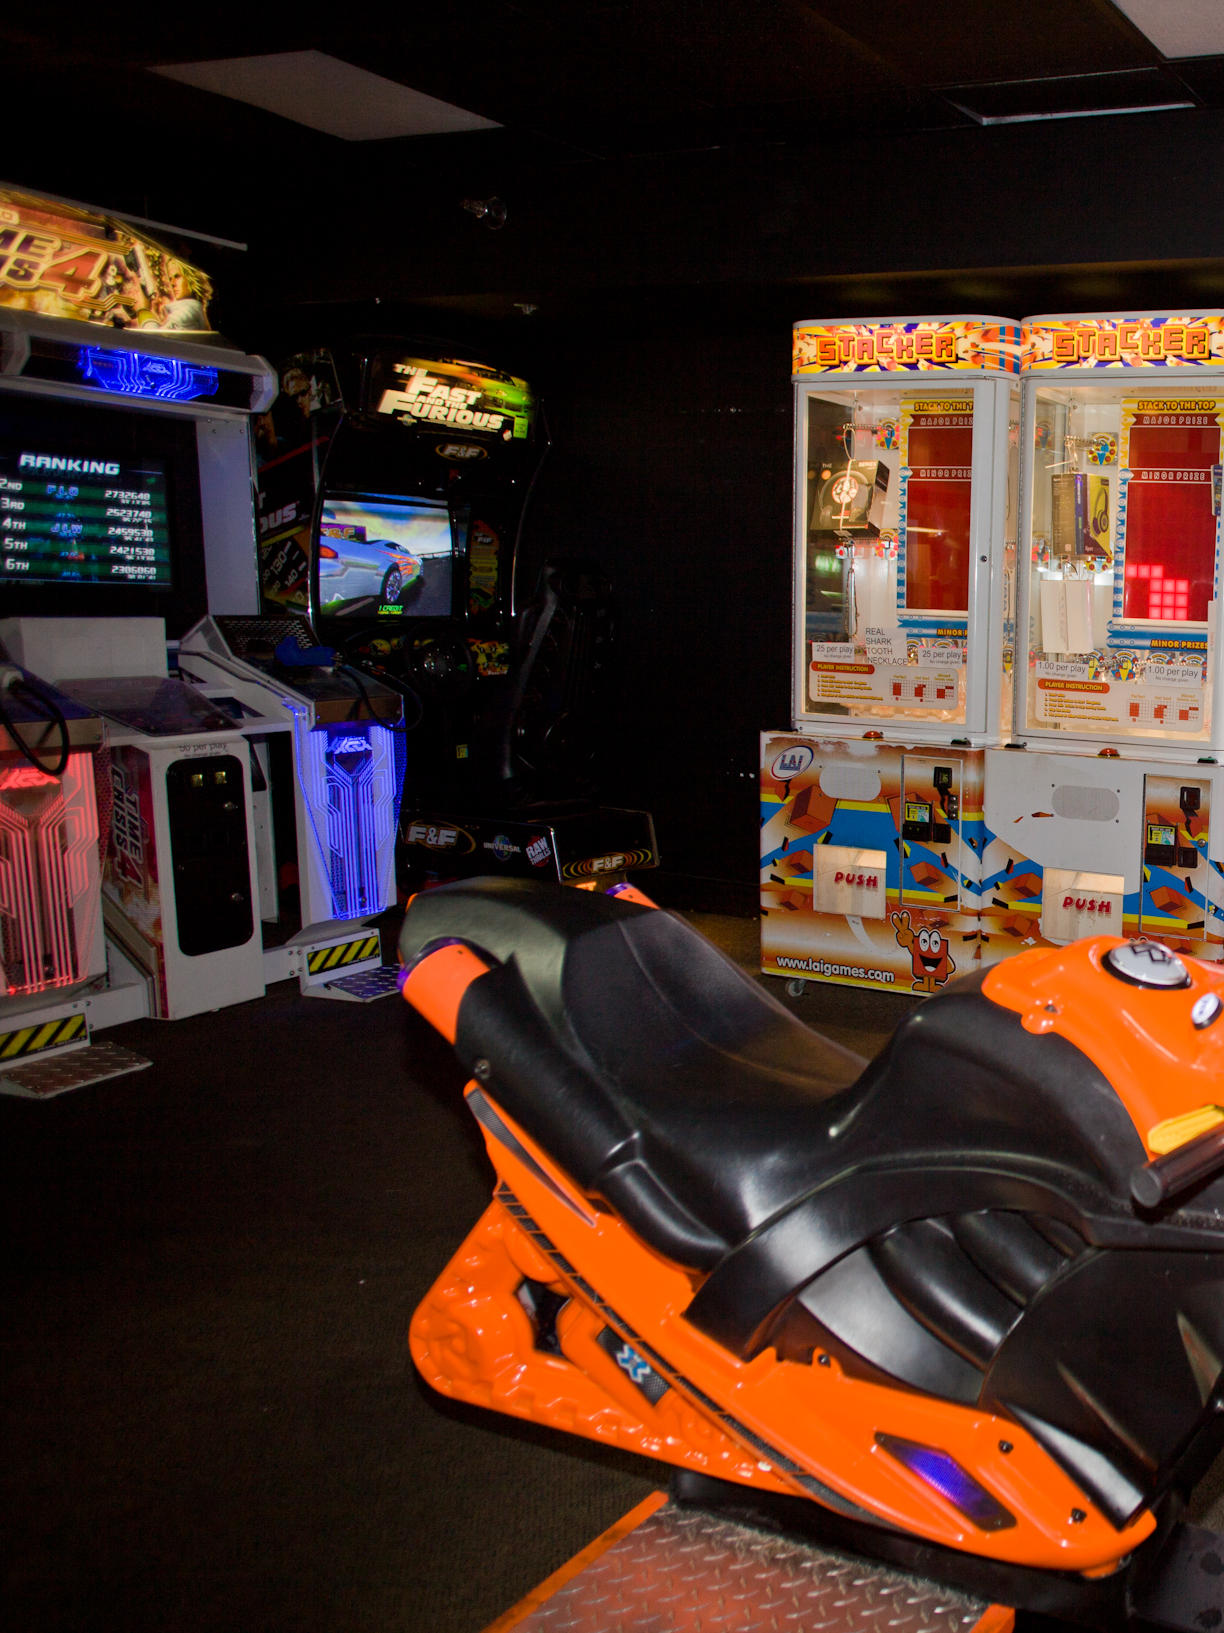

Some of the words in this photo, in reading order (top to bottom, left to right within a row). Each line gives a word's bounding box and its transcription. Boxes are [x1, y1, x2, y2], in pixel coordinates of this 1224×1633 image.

[816, 330, 957, 365] STACKER
[1052, 324, 1211, 362] STACKER
[393, 363, 428, 377] THE
[406, 375, 482, 405] FAST
[377, 389, 504, 429] FURIOUS
[1138, 402, 1165, 410] STACK
[1166, 402, 1178, 410] TO
[1179, 402, 1196, 410] THE
[1198, 402, 1216, 410] TOP
[920, 417, 950, 425] MAJOR
[952, 417, 974, 425] PRIZ
[1143, 416, 1176, 424] MAJOR
[1178, 416, 1208, 425] PRIZE
[20, 454, 120, 475] RANKING
[951, 469, 972, 477] PRIZ
[1141, 471, 1174, 480] MINOR
[1176, 472, 1205, 480] PRIZE
[1, 498, 25, 510] 3RD
[2, 518, 27, 530] 4TH
[4, 538, 28, 550] 5TH
[6, 558, 30, 570] 6TH
[866, 627, 885, 635] REAL
[827, 646, 838, 654] per
[840, 645, 853, 654] play
[1151, 640, 1179, 648] MINOR
[1181, 641, 1208, 649] PRIZES
[947, 650, 961, 659] play
[868, 657, 908, 666] NECKLACE
[1039, 662, 1054, 670] 1.00
[1056, 664, 1068, 672] per
[1070, 665, 1085, 673] play
[1149, 666, 1164, 674] 1.00
[1182, 669, 1198, 679] play
[1066, 682, 1103, 690] INSTRUCTION
[407, 826, 457, 846] F&F
[483, 841, 522, 853] UNIVERSAL
[526, 836, 548, 859] RAW
[592, 855, 624, 872] F&F
[834, 871, 878, 889] PUSH
[1062, 896, 1112, 914] PUSH
[775, 956, 895, 984] www.laigames.com
